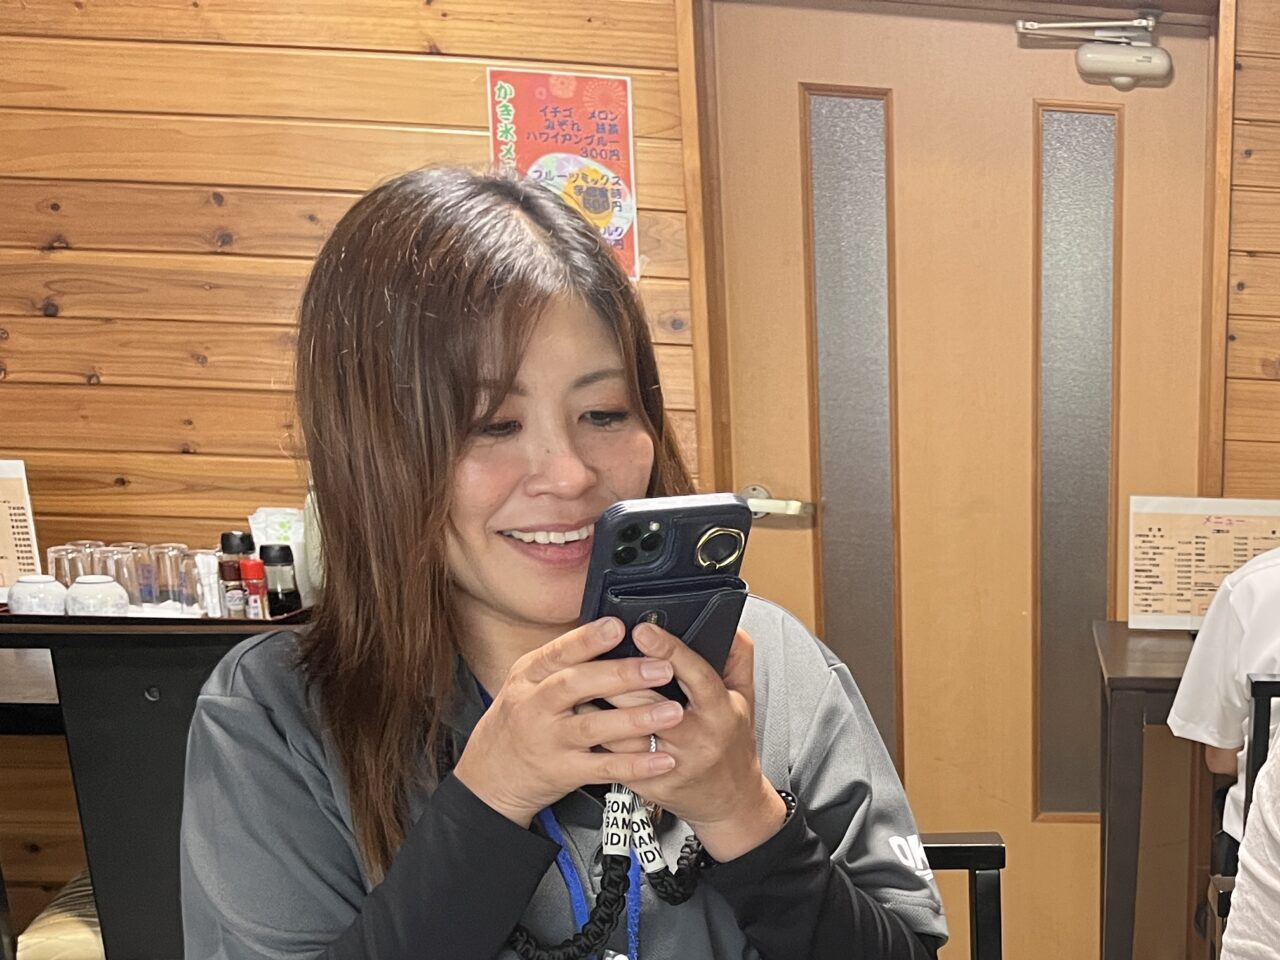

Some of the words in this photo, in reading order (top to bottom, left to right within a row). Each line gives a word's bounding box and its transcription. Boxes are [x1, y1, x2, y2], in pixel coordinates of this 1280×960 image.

[539, 106, 573, 118] イチゴ
[587, 109, 618, 121] メロン
[544, 118, 581, 131] みぞれ
[527, 131, 620, 146] ハワイアンブルー
[580, 147, 620, 161] 300円
[533, 169, 622, 186] フルーツミックス
